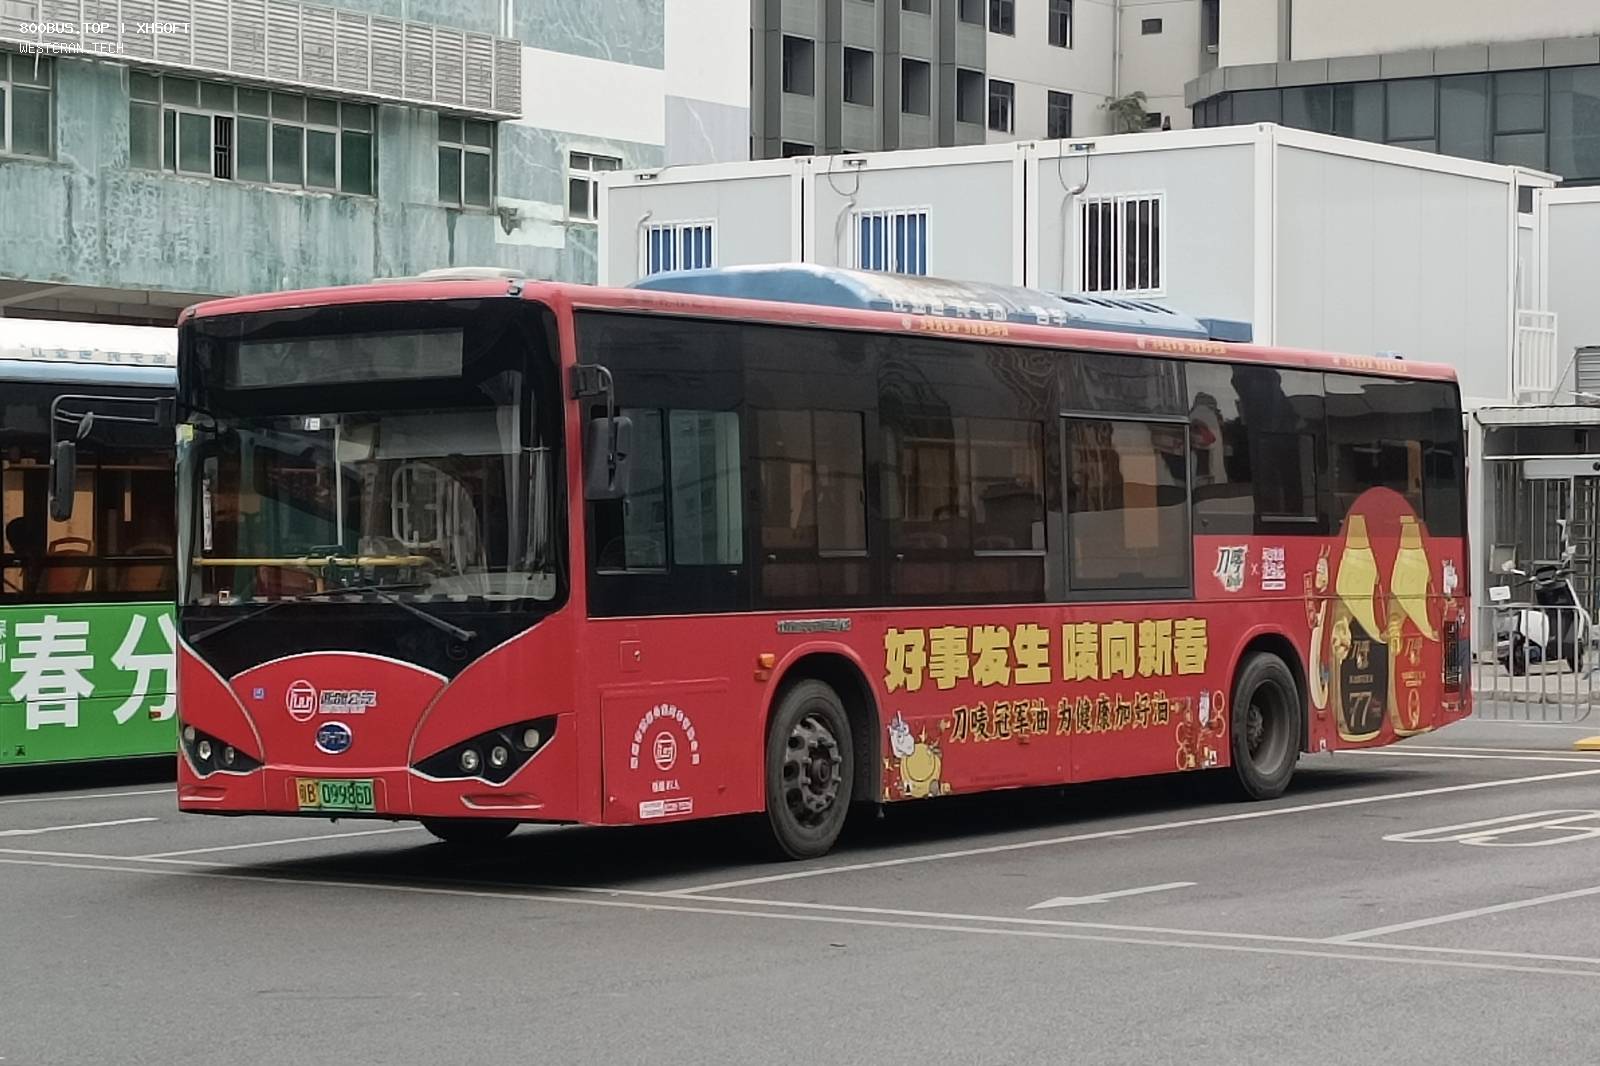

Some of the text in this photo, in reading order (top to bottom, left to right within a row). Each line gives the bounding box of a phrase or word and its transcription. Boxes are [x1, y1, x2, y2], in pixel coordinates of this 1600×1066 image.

[9, 613, 176, 730] 春分
[884, 617, 1208, 693] 好事发生 唛向新春
